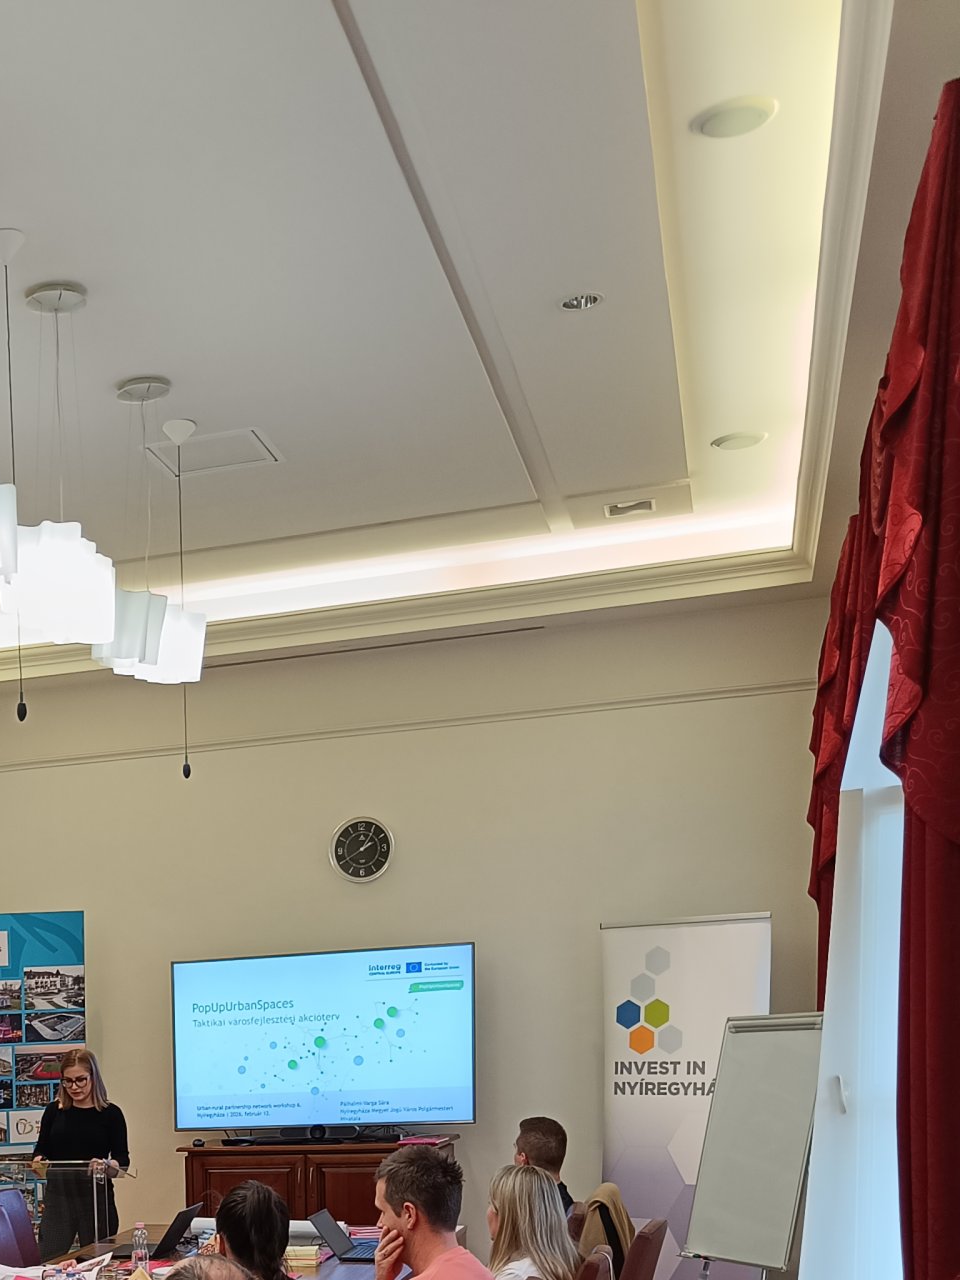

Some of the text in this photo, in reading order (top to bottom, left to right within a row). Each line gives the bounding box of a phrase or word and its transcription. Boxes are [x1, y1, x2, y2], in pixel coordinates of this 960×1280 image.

[337, 847, 343, 855] 9
[381, 843, 387, 852] 3
[359, 868, 365, 876] 6
[192, 999, 294, 1014] PopUpUrbanSpaces
[192, 1019, 226, 1028] Taktikai
[614, 1061, 706, 1075] INVEST IN
[613, 1078, 716, 1096] NYÍREGYHÁ
